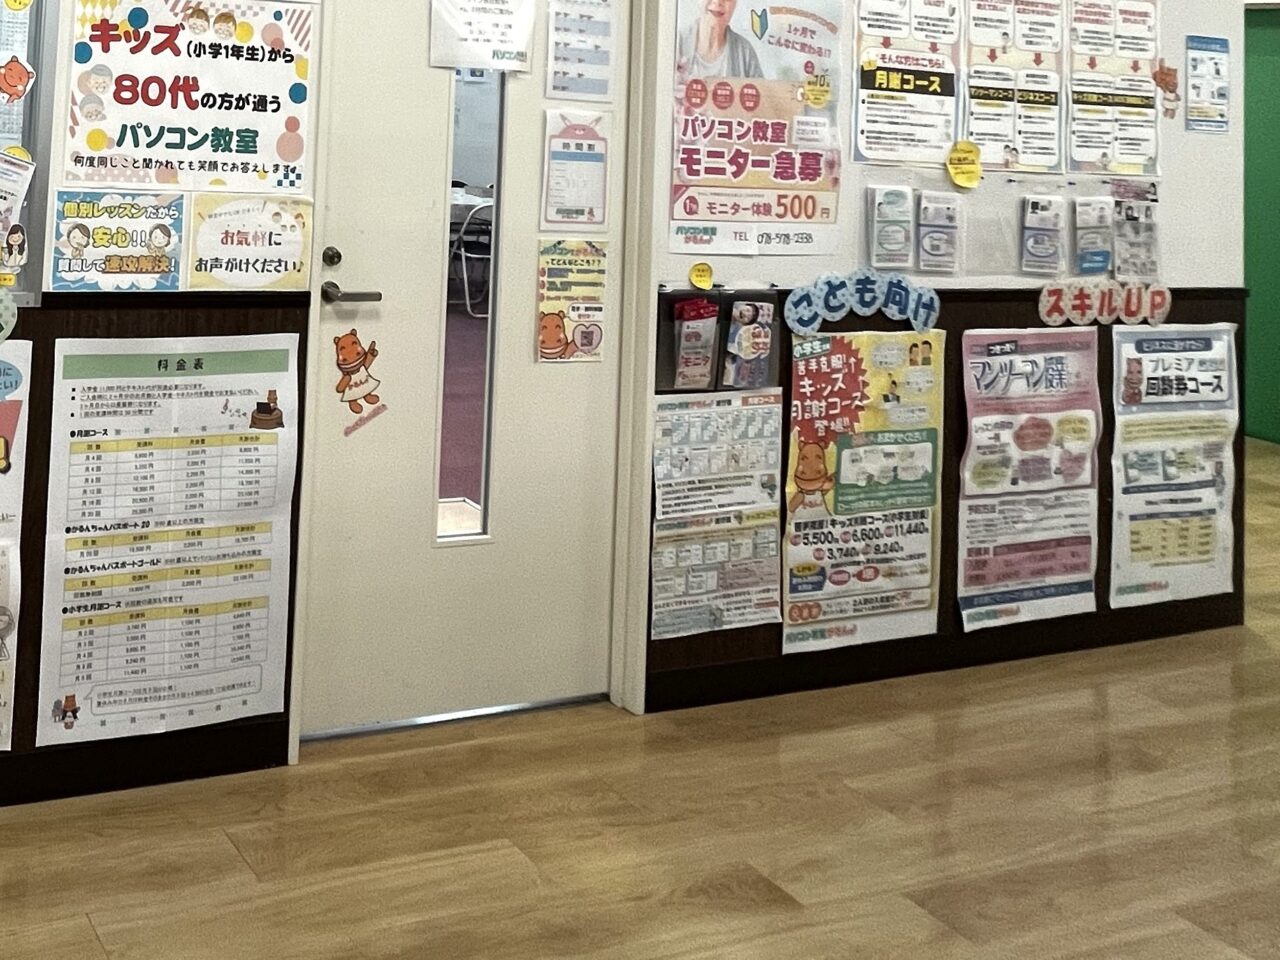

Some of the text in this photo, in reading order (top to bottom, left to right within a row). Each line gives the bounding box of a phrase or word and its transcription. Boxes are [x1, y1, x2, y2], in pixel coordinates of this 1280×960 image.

[112, 74, 281, 113] 80代の方が通う
[116, 123, 259, 155] パソコン教室
[681, 116, 787, 144] パソコン教室
[680, 147, 823, 181] モニター急募
[63, 201, 179, 220] 個別レッスンだから
[707, 201, 772, 217] モニター体験
[221, 230, 282, 247] お気軽に
[733, 232, 749, 240] TEL
[195, 257, 296, 273] お声がけください
[792, 274, 936, 328] こども向け
[1044, 286, 1168, 320] スキルUP
[800, 373, 846, 396] キッズ
[792, 392, 863, 420] 月謝コース
